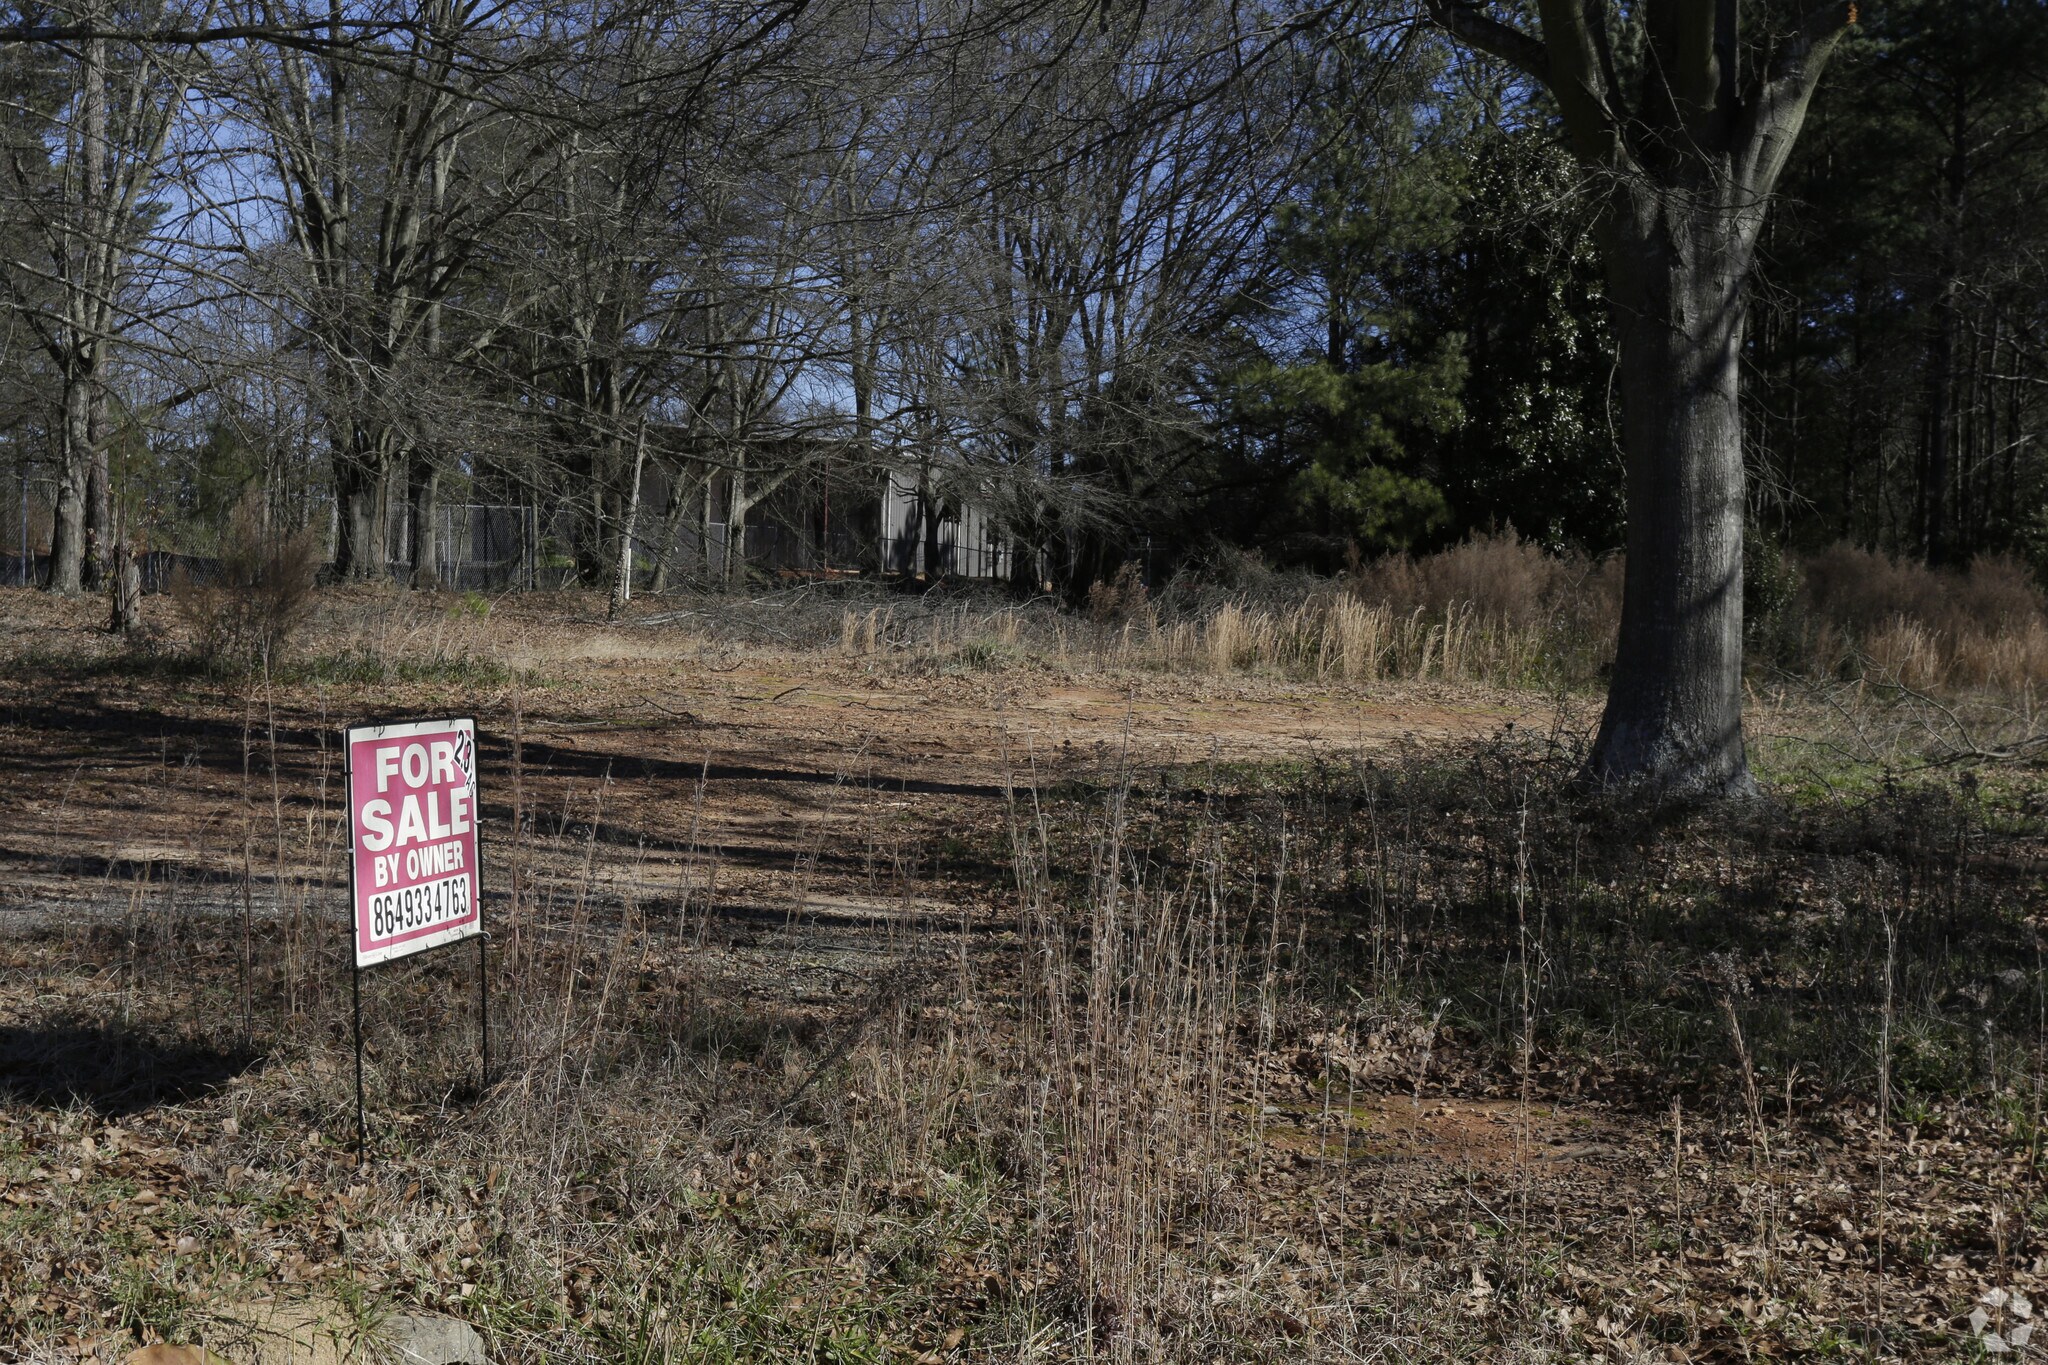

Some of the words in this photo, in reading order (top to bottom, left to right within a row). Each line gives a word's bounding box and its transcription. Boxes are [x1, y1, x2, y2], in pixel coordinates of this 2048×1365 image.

[376, 741, 455, 793] FOR
[361, 786, 470, 852] SALE
[374, 853, 401, 888] BY
[406, 840, 464, 881] OWNER
[374, 877, 467, 937] 8649334763
